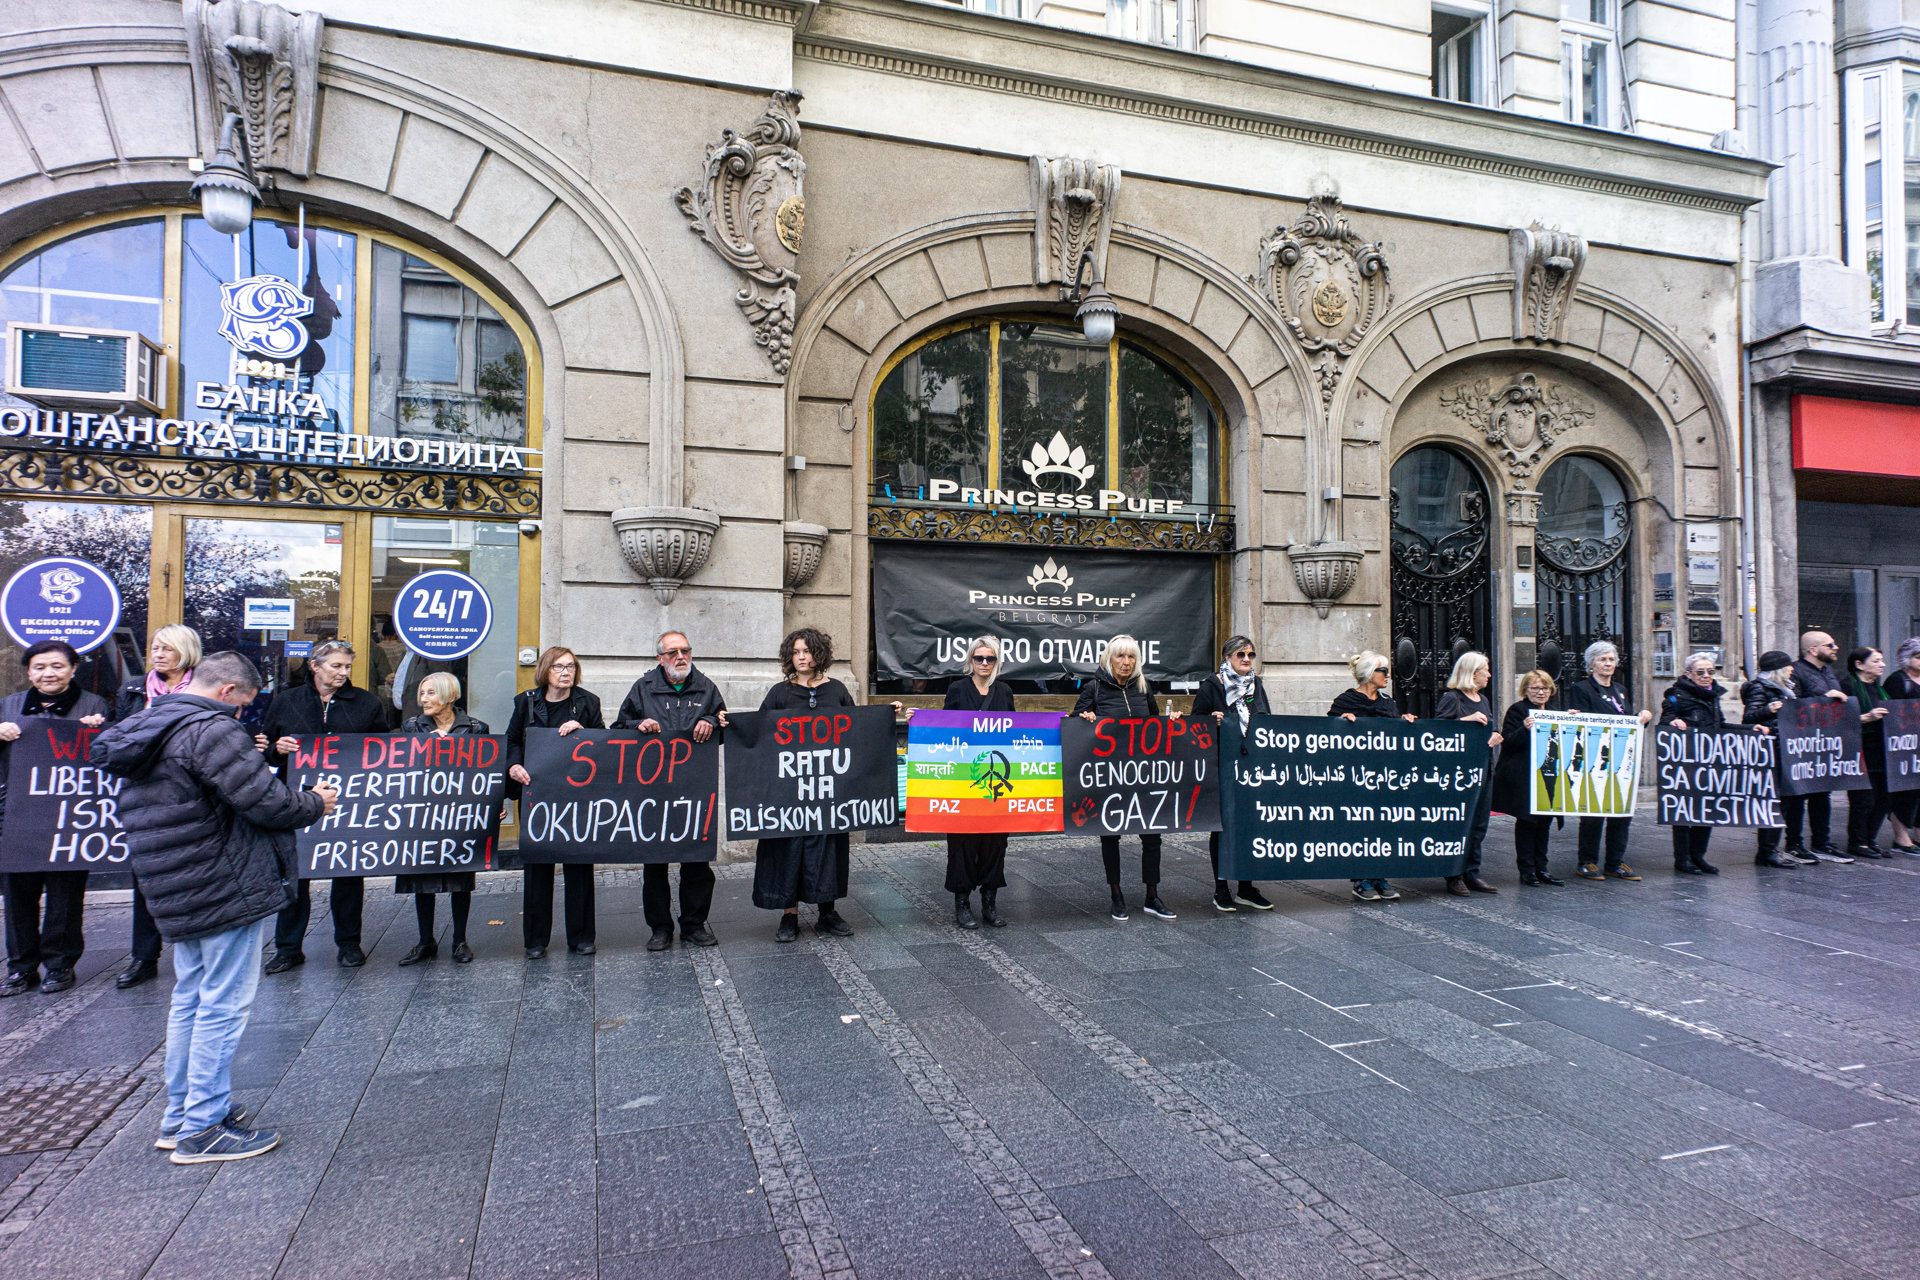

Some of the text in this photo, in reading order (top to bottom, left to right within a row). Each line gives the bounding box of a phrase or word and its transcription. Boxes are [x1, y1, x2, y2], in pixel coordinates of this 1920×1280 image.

[236, 358, 286, 379] 1921
[196, 381, 330, 420] БАНКА
[252, 426, 524, 473] ШТЕДИОНИЦА
[929, 478, 1184, 514] PRINCESS PUFF
[49, 606, 72, 614] 1921
[413, 588, 474, 624] 24/7
[968, 590, 1074, 606] PRINCESS
[20, 619, 101, 627] ЕКСПОЗИТУРА
[25, 627, 62, 635] Branch
[999, 612, 1100, 624] BELGRADE
[936, 637, 1161, 664] USRO OTVARJE
[973, 717, 1013, 733] МИР
[1796, 702, 1846, 729] STOP
[774, 714, 852, 745] STOP
[1092, 717, 1188, 757] STOP
[1254, 727, 1466, 754] Stop genocidu u Gazi!
[295, 736, 500, 770] WE DEMAND
[1786, 728, 1843, 760] exporting
[566, 738, 692, 787] STOP
[778, 748, 851, 778] RATU
[1020, 761, 1057, 776] PACE
[1079, 758, 1207, 788] GENOCIDU U
[1791, 761, 1815, 780] arms
[1816, 755, 1827, 777] to
[471, 772, 503, 796] OF
[1660, 764, 1691, 790] SA
[56, 798, 124, 830] ISR
[303, 802, 491, 834] ALESTINIAN
[929, 799, 961, 814] PAZ
[1008, 798, 1055, 813] PEACE
[1252, 836, 1467, 862] Stop genocide in Gaza!
